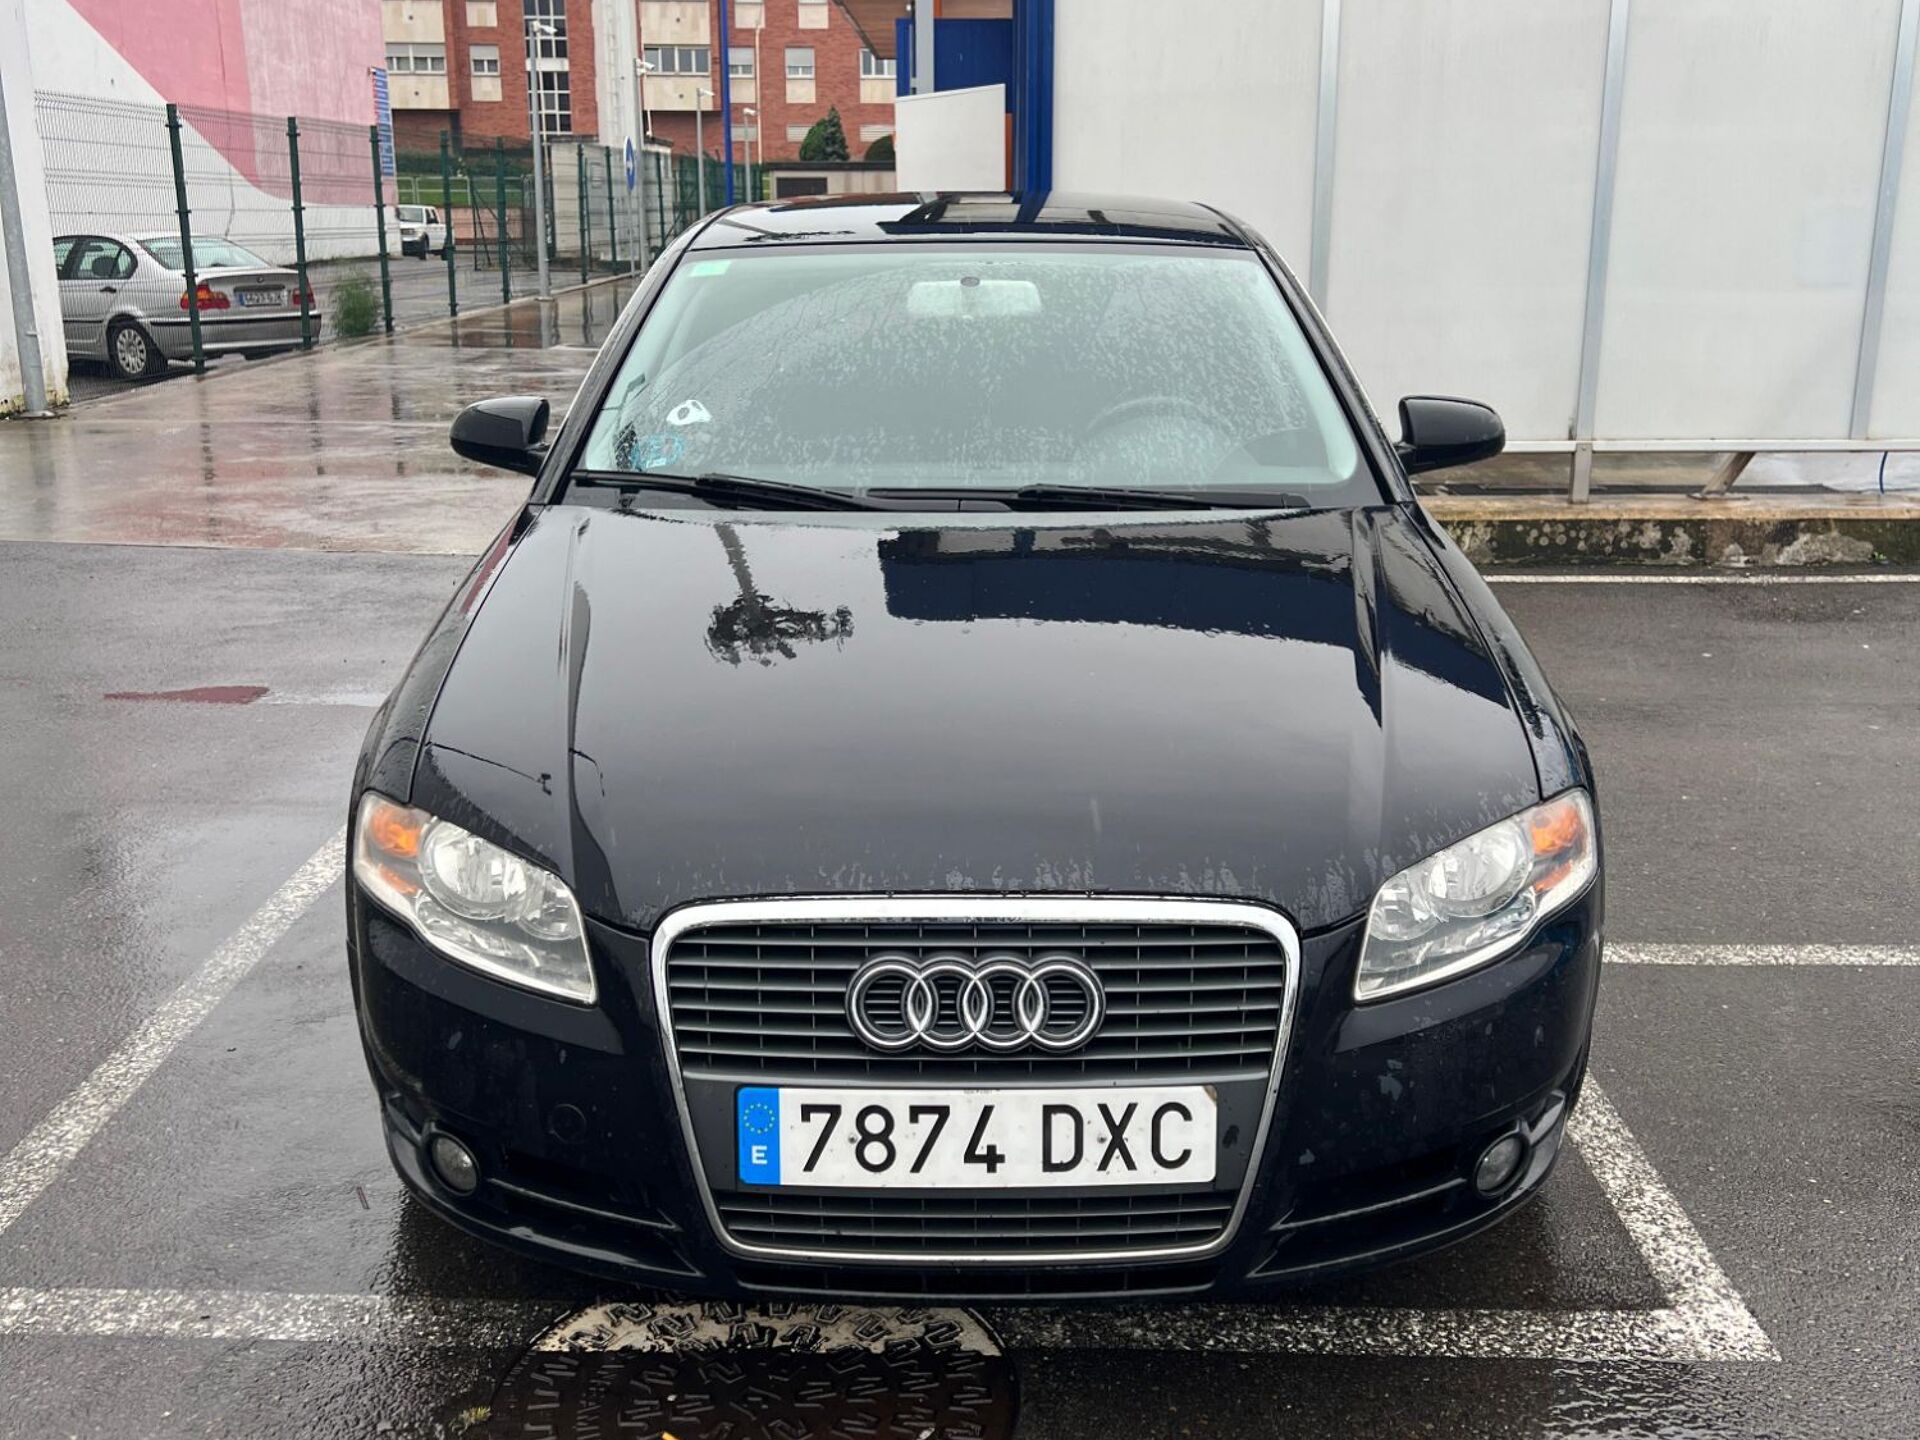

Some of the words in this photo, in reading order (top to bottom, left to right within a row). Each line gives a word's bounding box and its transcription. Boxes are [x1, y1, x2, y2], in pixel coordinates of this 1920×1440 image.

[751, 1145, 768, 1165] E
[800, 1103, 1005, 1174] 7874
[1041, 1101, 1193, 1173] DXC
